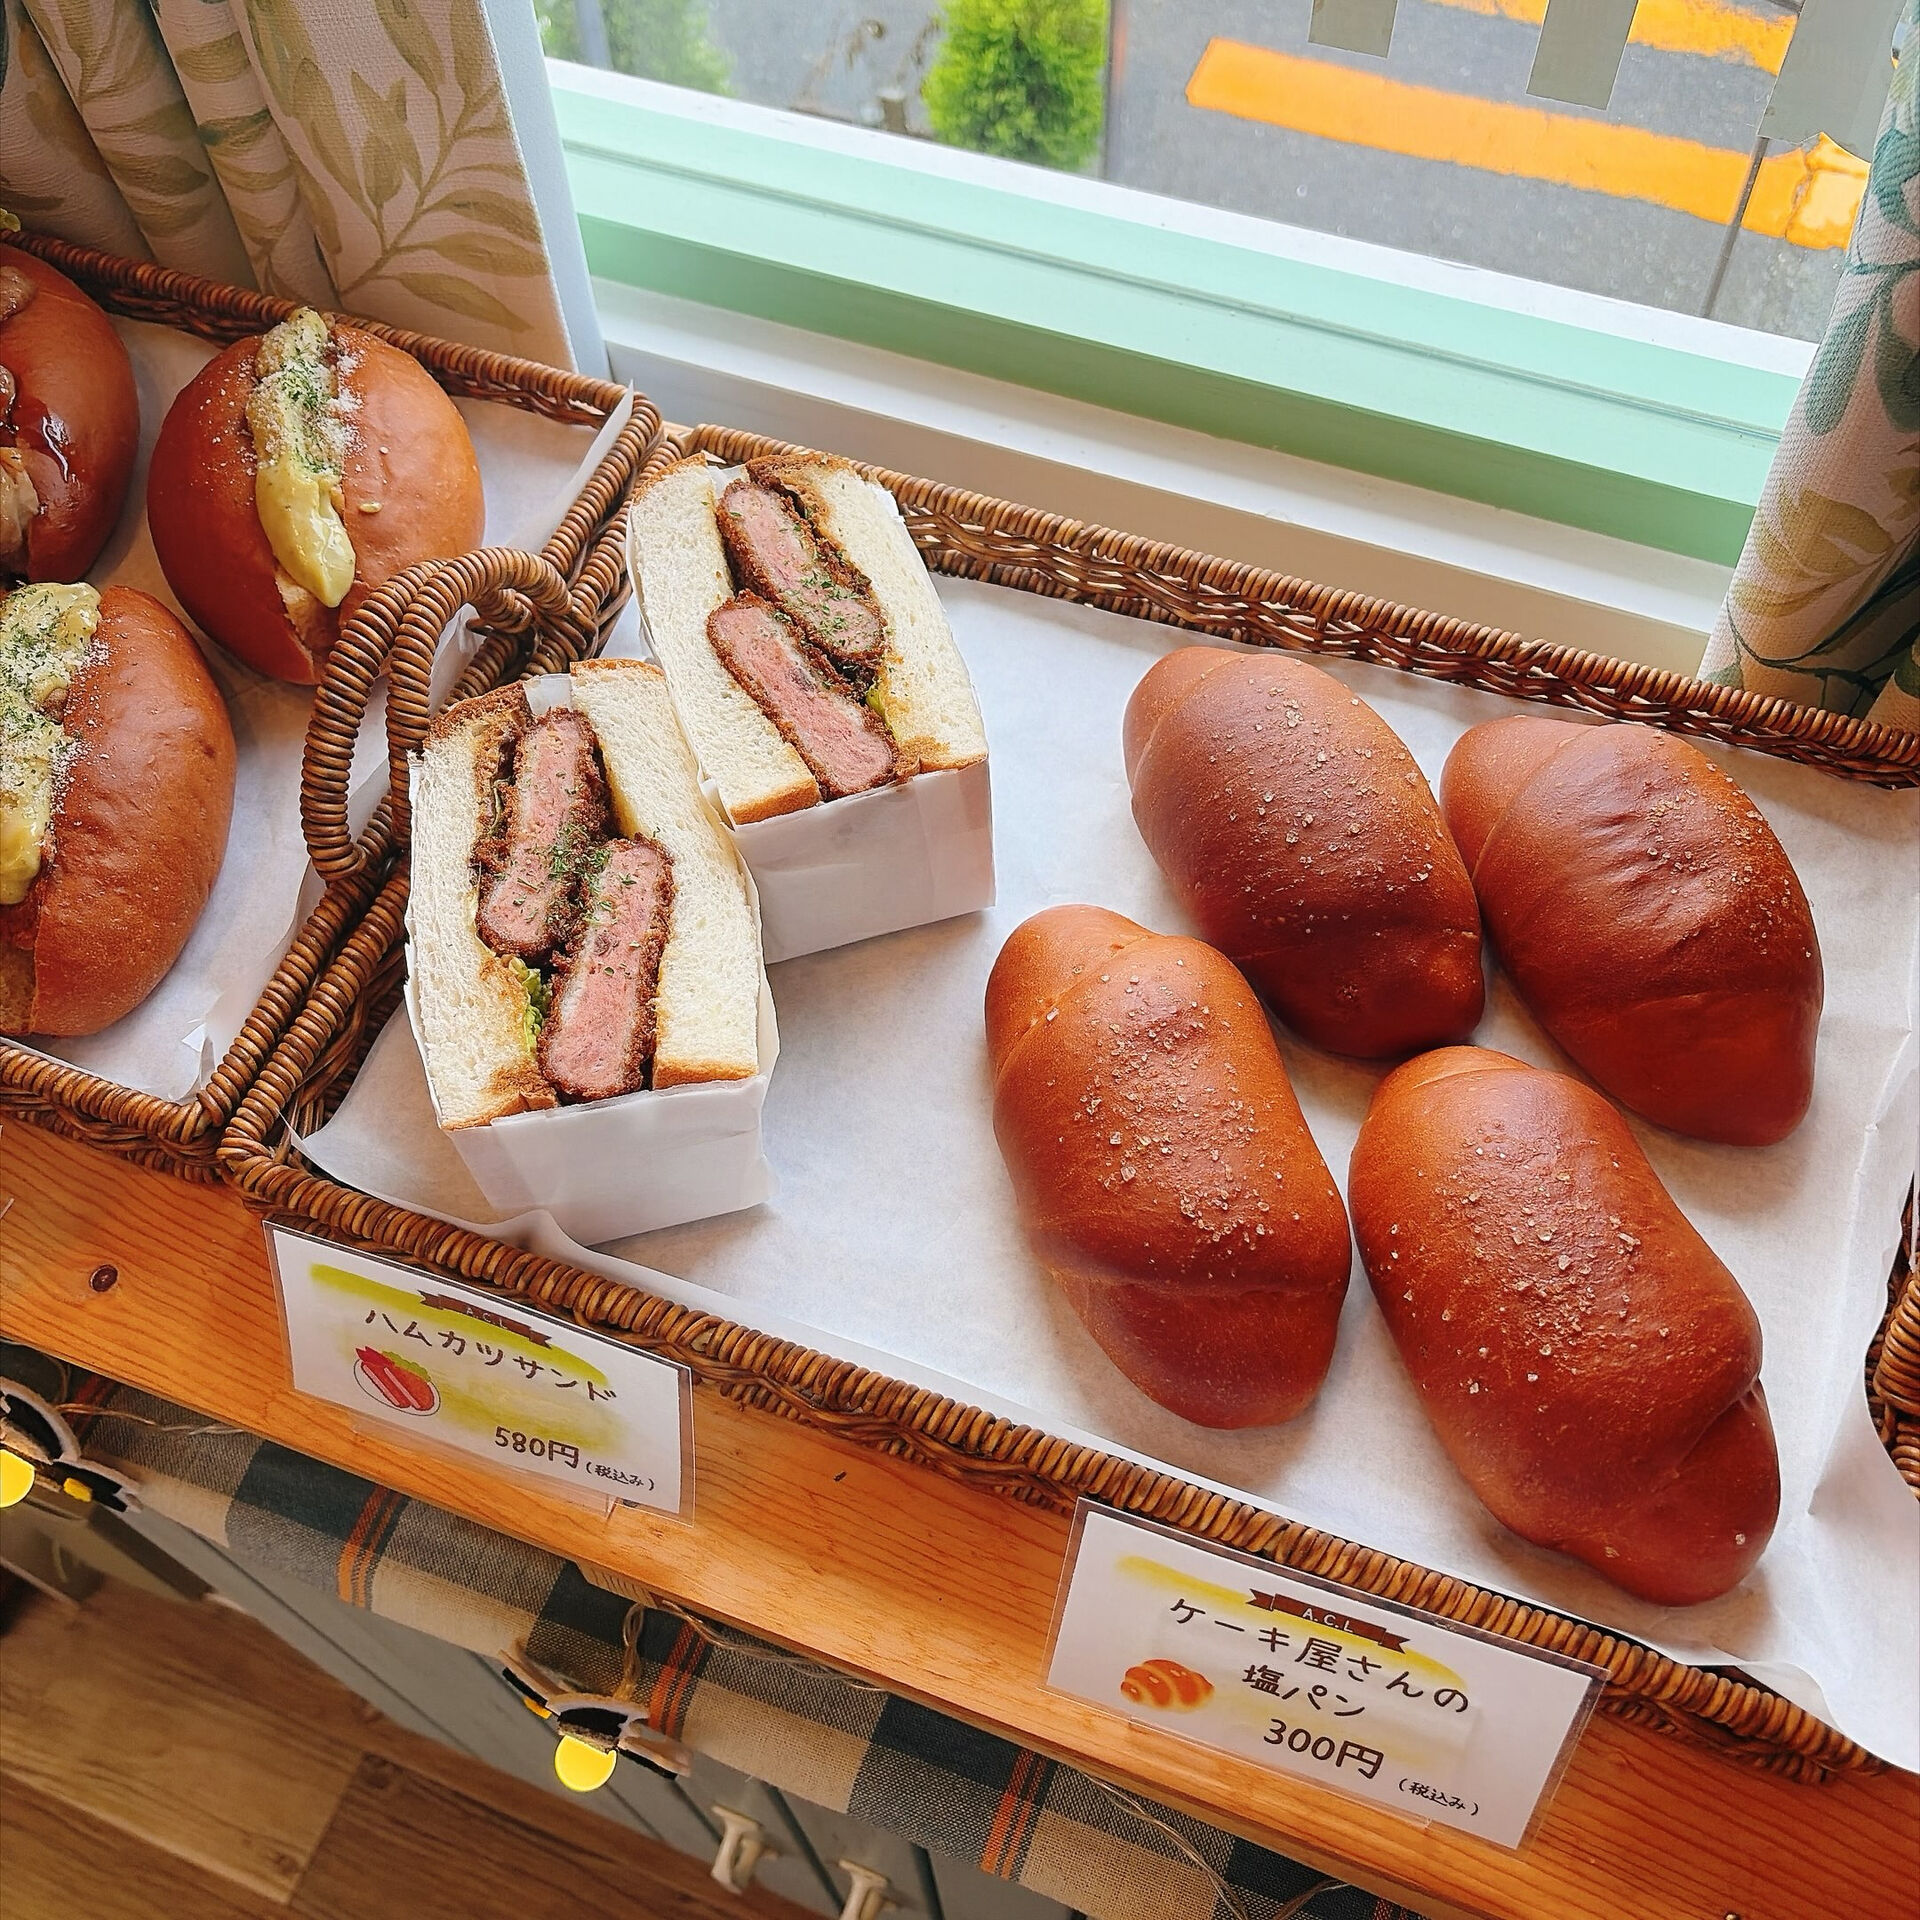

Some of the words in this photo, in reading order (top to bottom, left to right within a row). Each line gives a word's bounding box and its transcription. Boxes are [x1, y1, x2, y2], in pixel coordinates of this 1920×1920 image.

[365, 1310, 618, 1401] ハムカツサンド
[494, 1426, 580, 1469] 580円
[1170, 1598, 1469, 1713] ケーキ屋さんの
[1242, 1664, 1366, 1717] 塩パン
[1263, 1718, 1385, 1780] 300円
